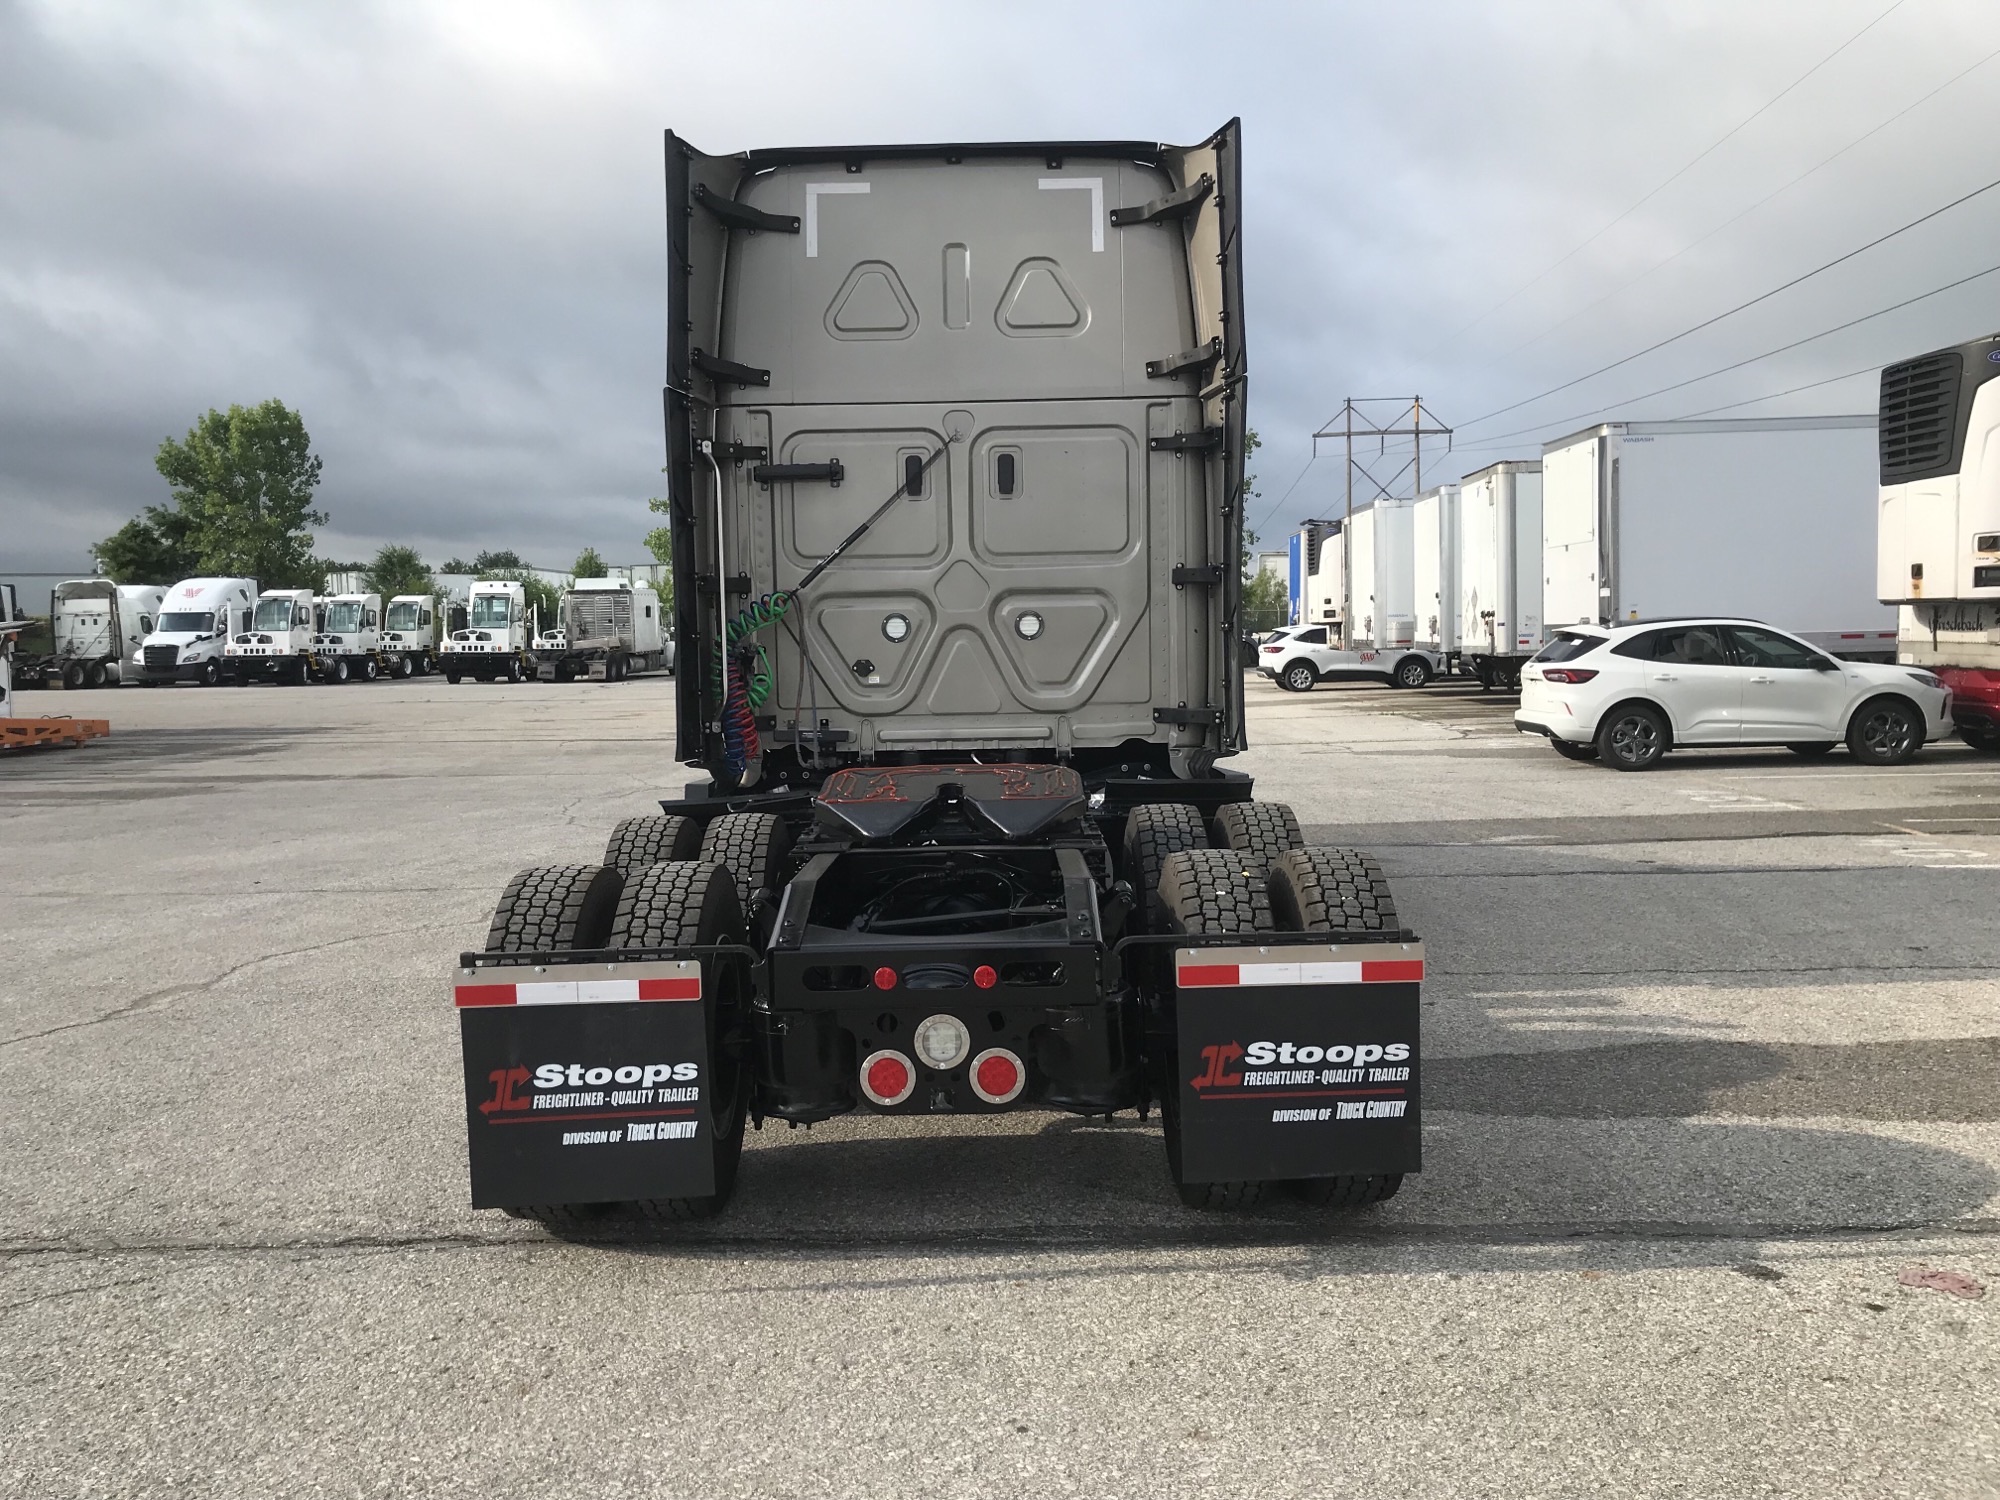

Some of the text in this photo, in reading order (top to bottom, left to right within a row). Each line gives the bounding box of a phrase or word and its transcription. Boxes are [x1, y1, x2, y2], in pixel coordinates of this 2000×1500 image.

[1622, 436, 1655, 444] WABASH
[1244, 1041, 1411, 1067] Stoops
[533, 1062, 699, 1089] Stoops
[1368, 1066, 1410, 1083] TRAILER
[657, 1086, 699, 1103] TRAILER
[1272, 1100, 1408, 1123] DIVISION OF TRUCK COUNTRY
[562, 1121, 699, 1146] DIVISION OF TRUCK COUNTRY
